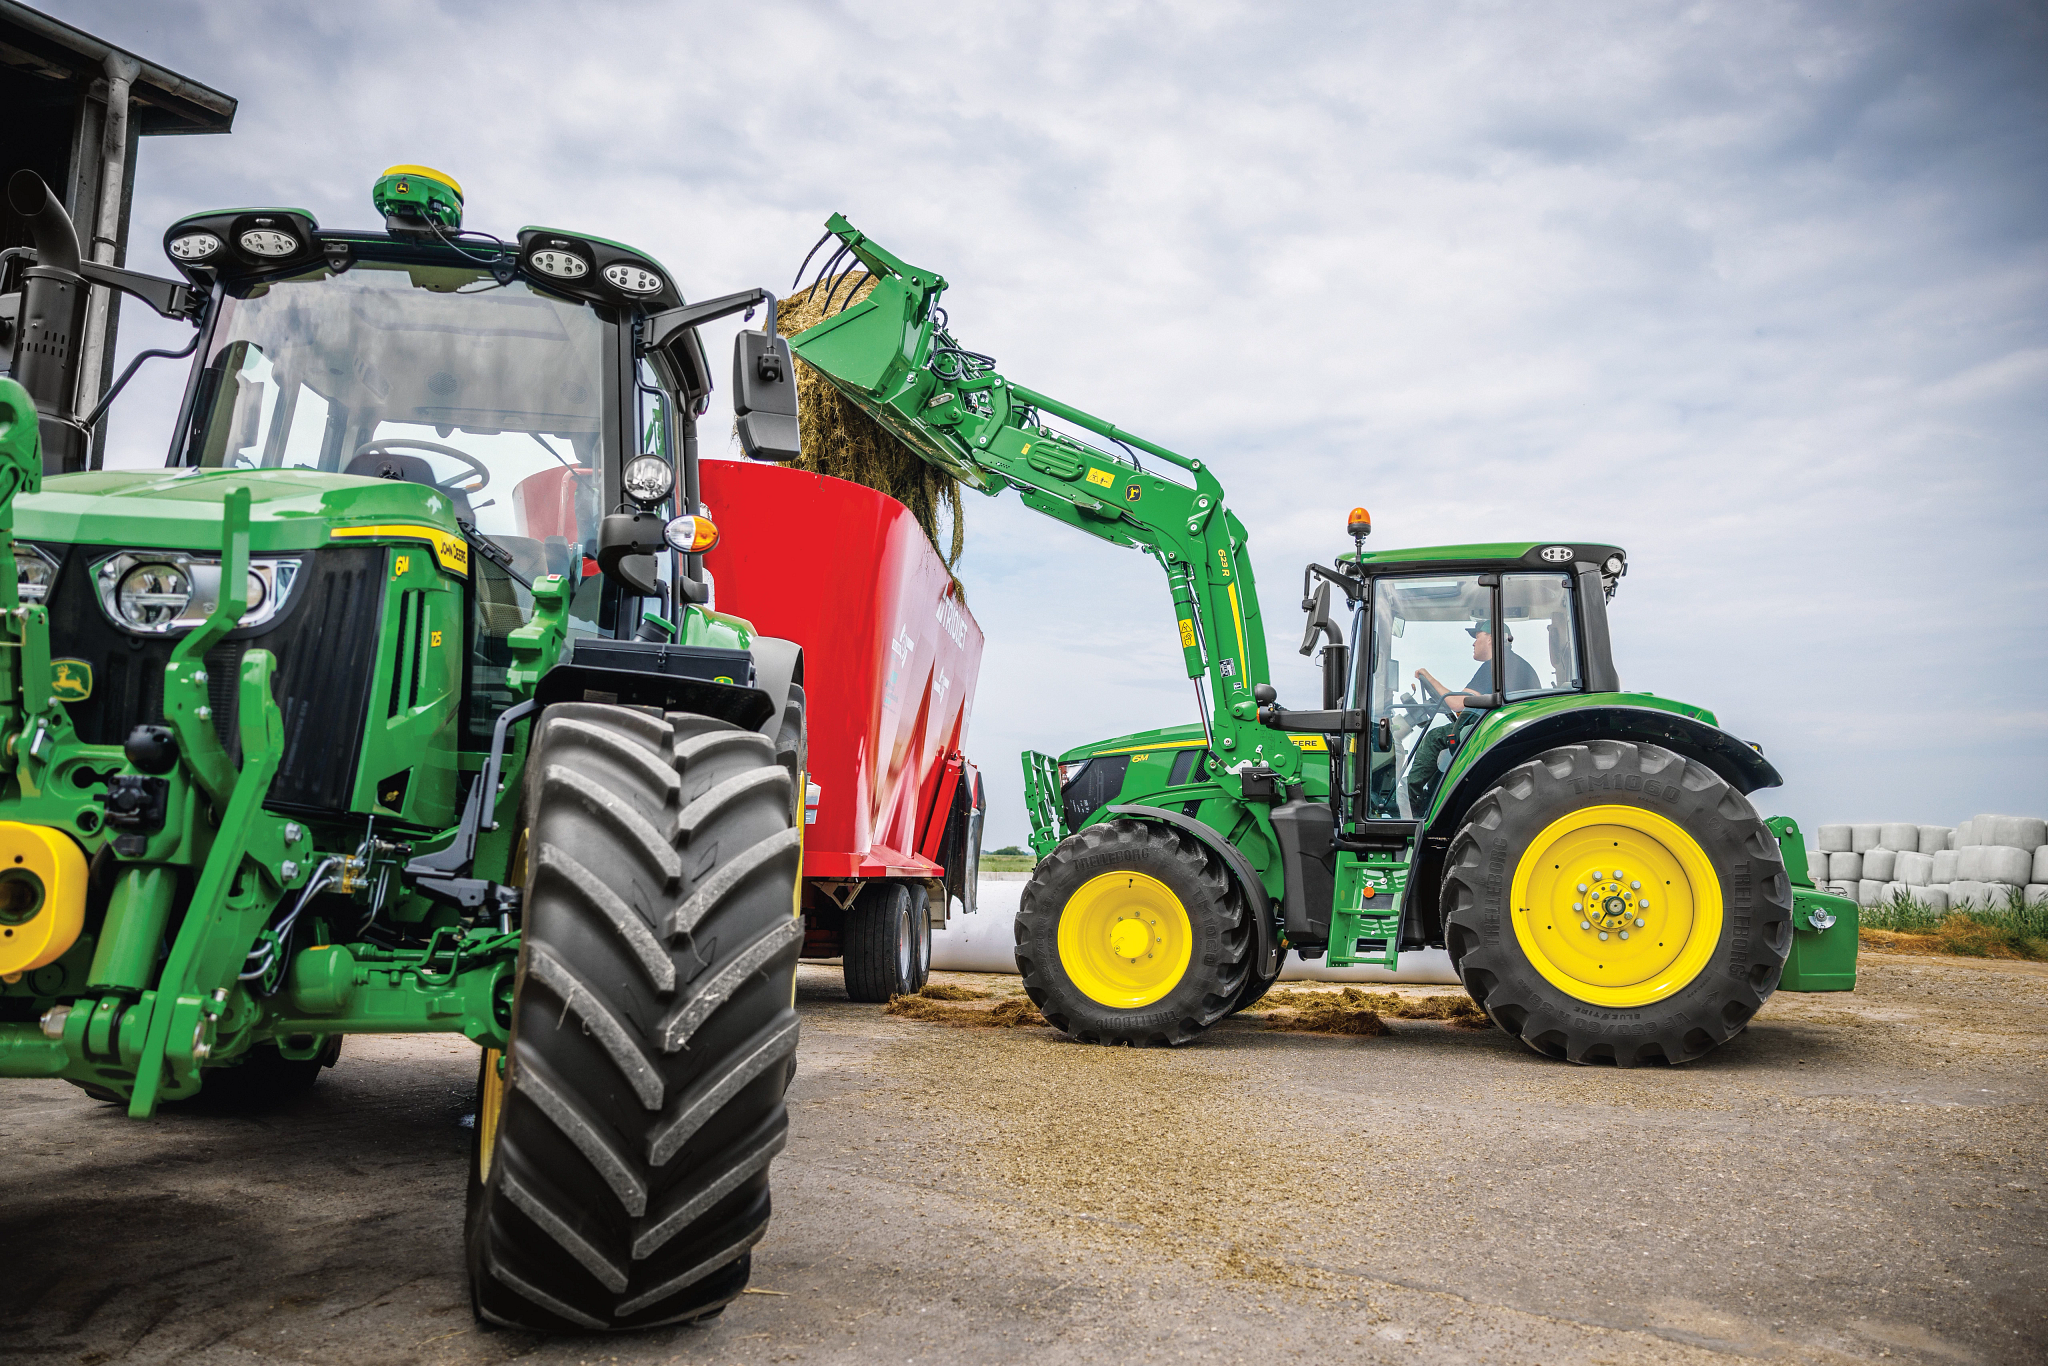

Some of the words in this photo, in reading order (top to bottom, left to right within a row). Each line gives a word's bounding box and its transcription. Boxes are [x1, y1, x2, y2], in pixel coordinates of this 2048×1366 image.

[440, 541, 452, 557] JOHN
[453, 543, 467, 564] DEERE
[1217, 548, 1229, 568] 623
[395, 555, 410, 577] 6M
[1221, 568, 1231, 578] R
[1131, 753, 1150, 764] 6M
[1566, 773, 1682, 804] TM1060
[1484, 836, 1508, 949] TRELLEBORG
[1728, 860, 1751, 980] TRELLEBORG
